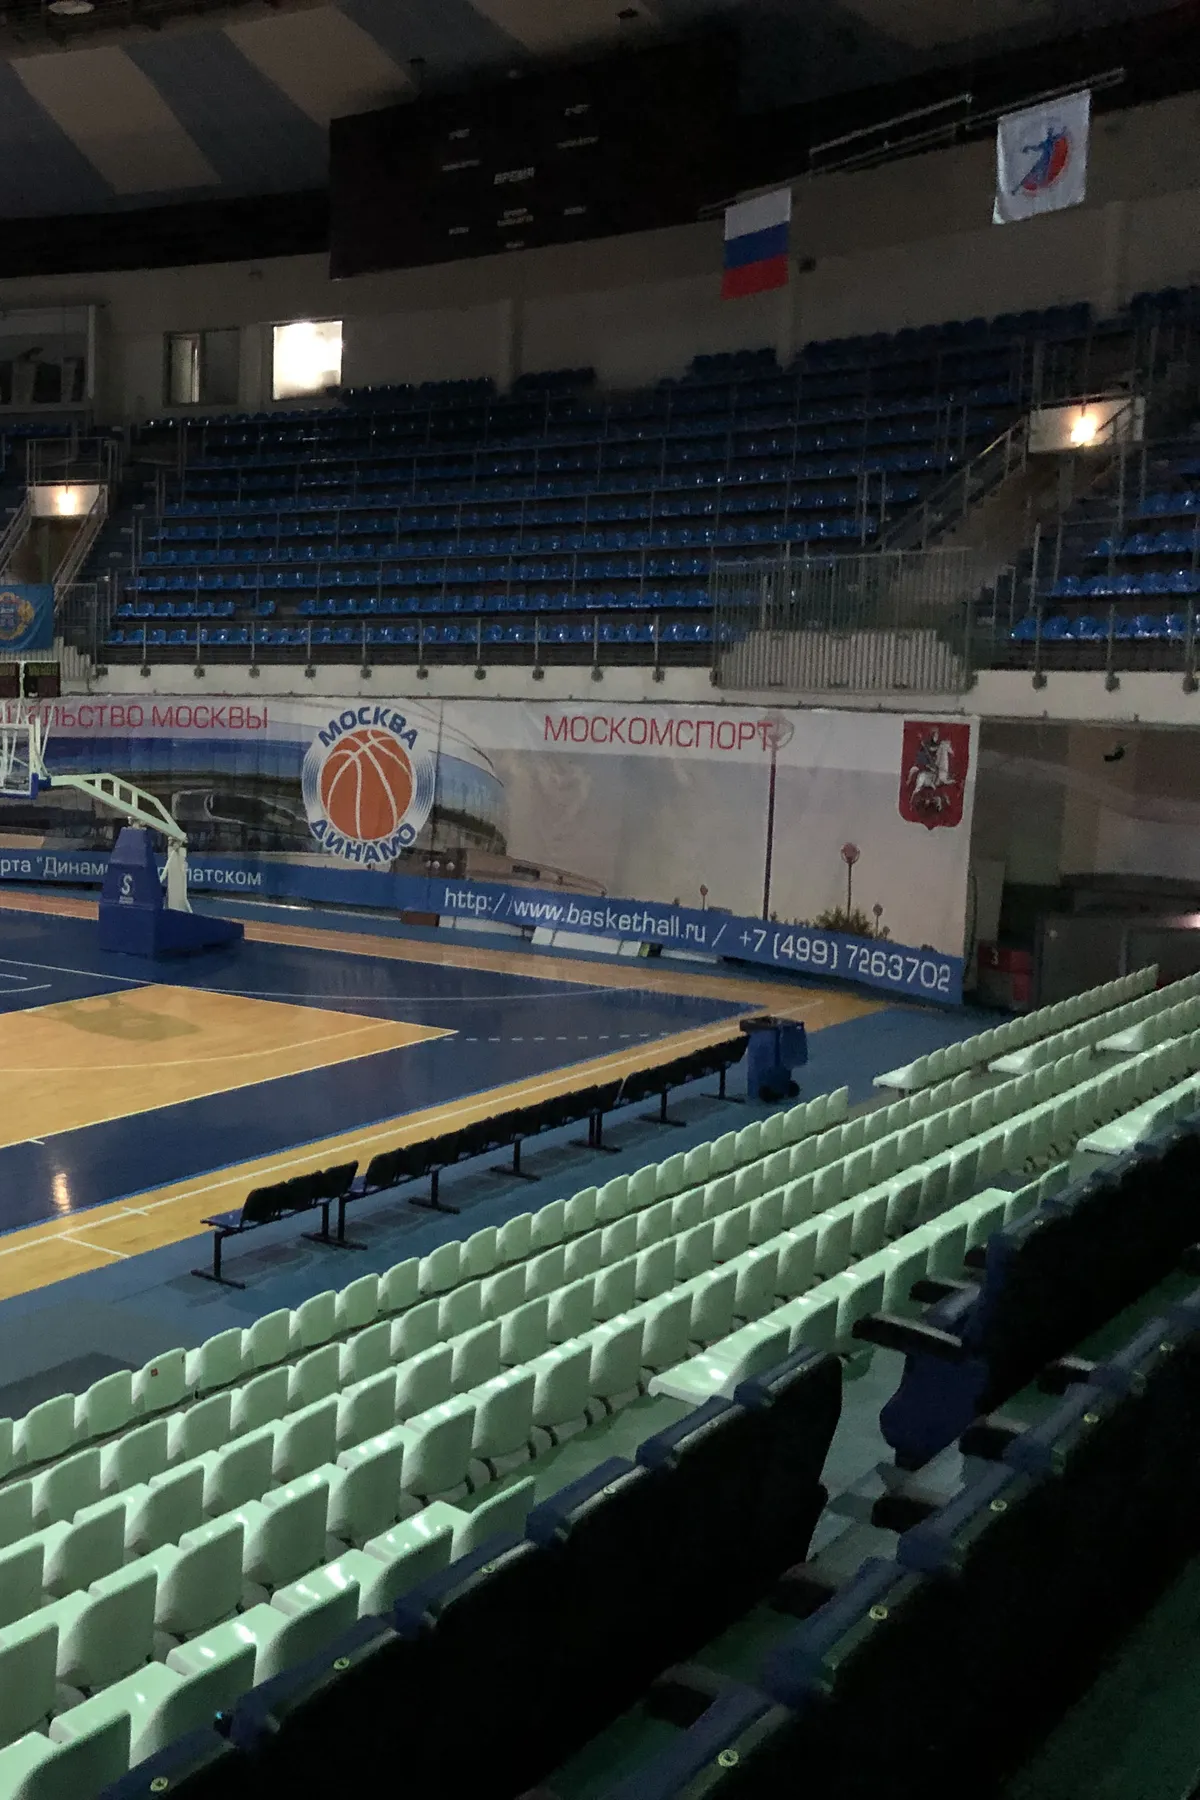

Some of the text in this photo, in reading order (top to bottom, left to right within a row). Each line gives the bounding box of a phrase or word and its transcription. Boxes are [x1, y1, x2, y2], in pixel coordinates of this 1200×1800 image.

[151, 705, 268, 729] МОСКВЫ
[318, 706, 418, 750] МОСКВА
[544, 715, 774, 751] МОСКОМСПОРТ
[310, 819, 416, 864] ДИНАМО
[36, 855, 109, 878] "Динам
[739, 928, 768, 953] +7
[773, 932, 838, 970] (499)
[845, 944, 951, 993] 7263702
